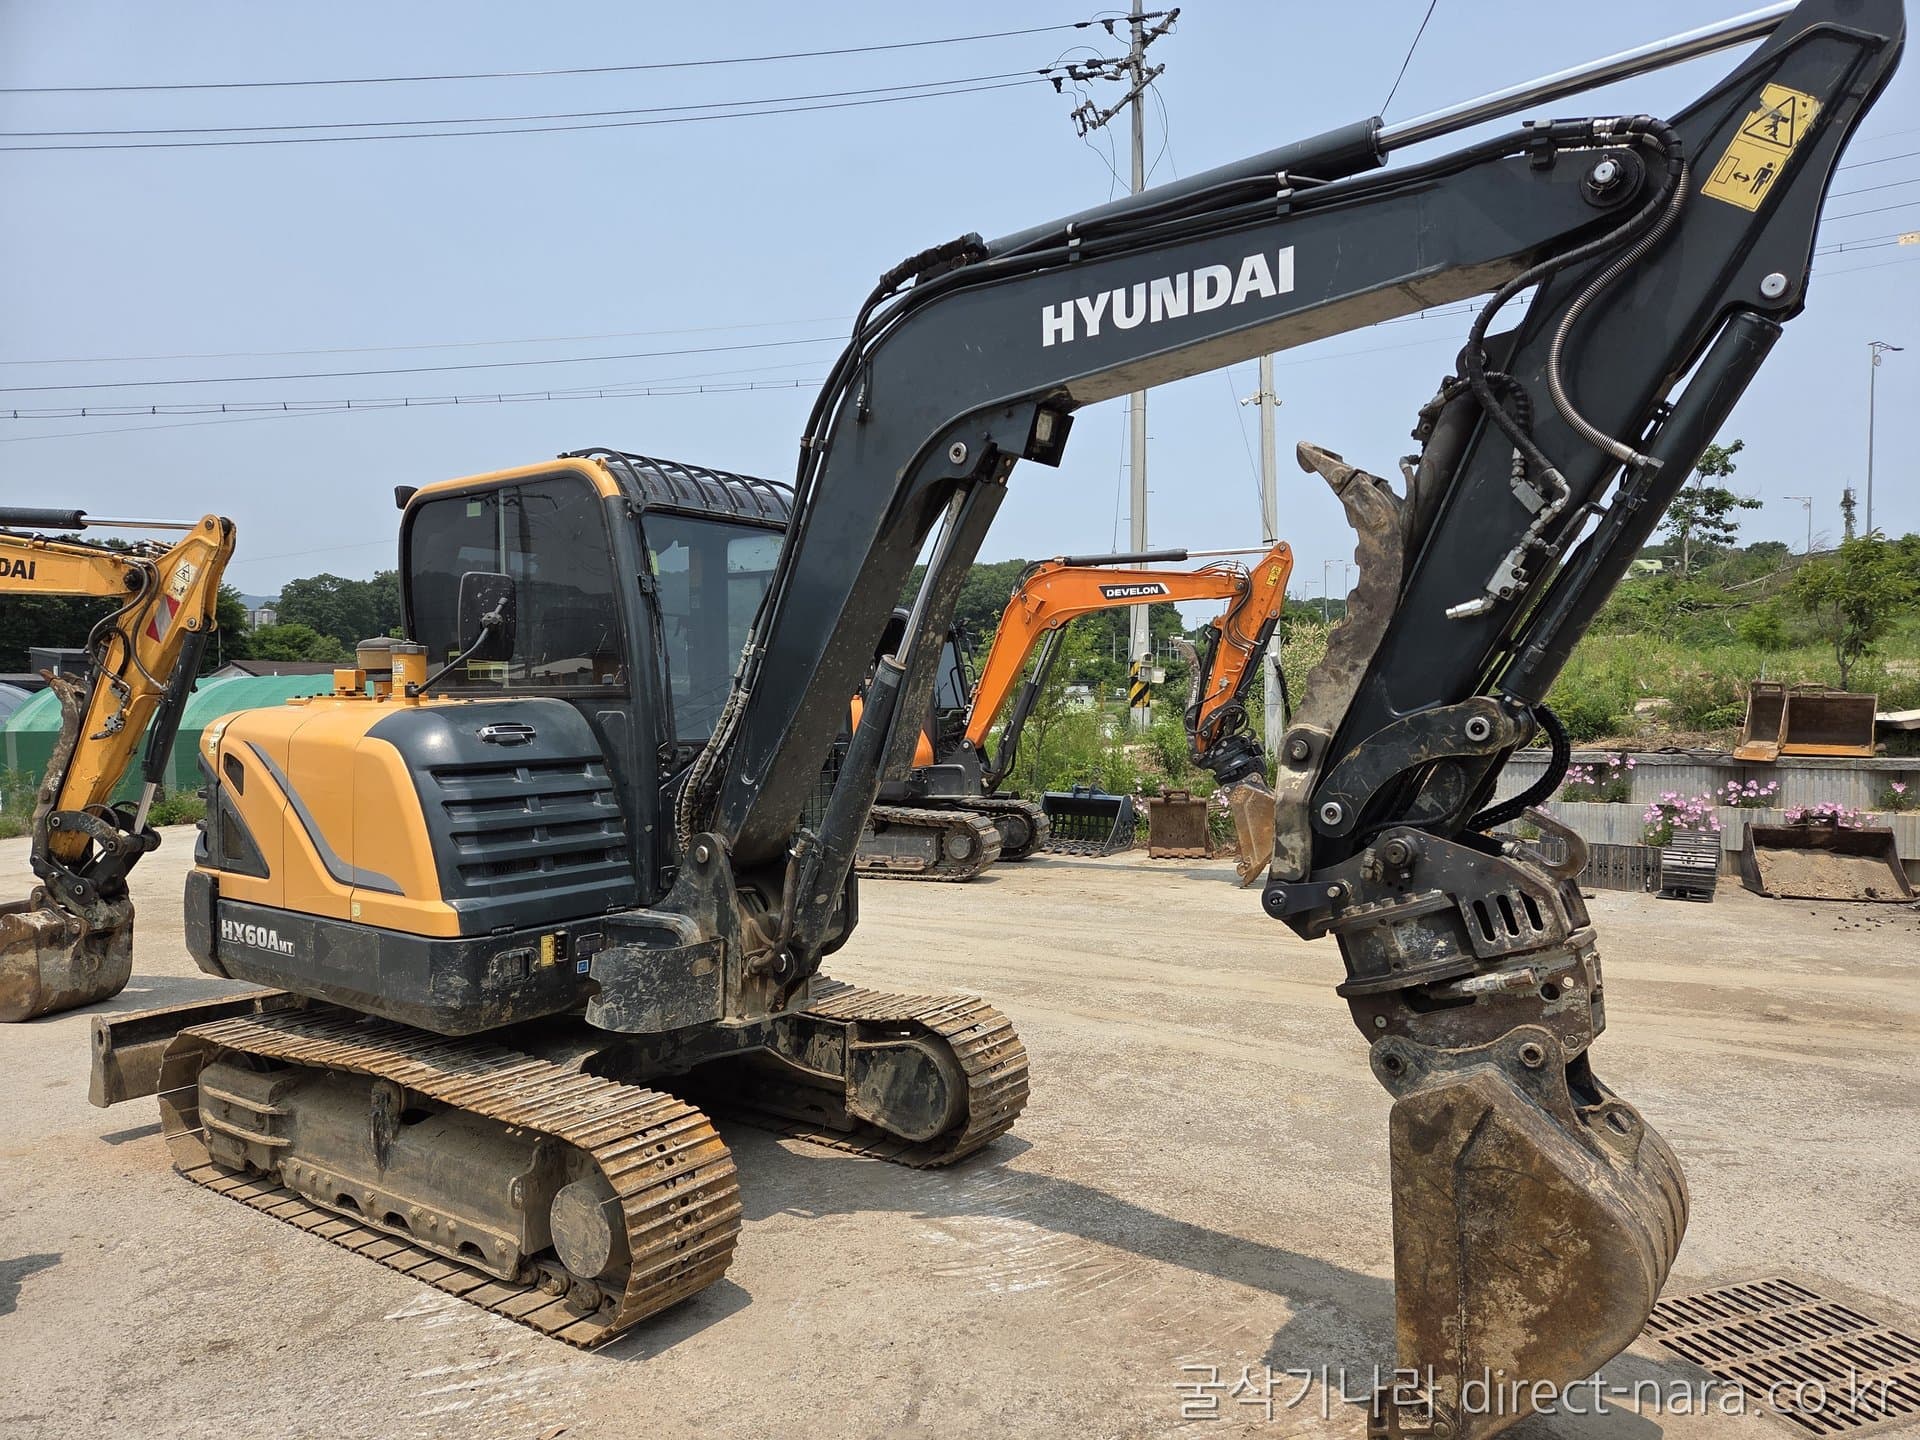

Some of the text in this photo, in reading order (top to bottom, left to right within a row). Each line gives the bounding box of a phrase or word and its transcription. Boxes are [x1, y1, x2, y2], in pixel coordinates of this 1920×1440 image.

[1042, 246, 1295, 347] HYUNDAI
[0, 558, 35, 580] DAI
[1107, 586, 1158, 597] DEVELON
